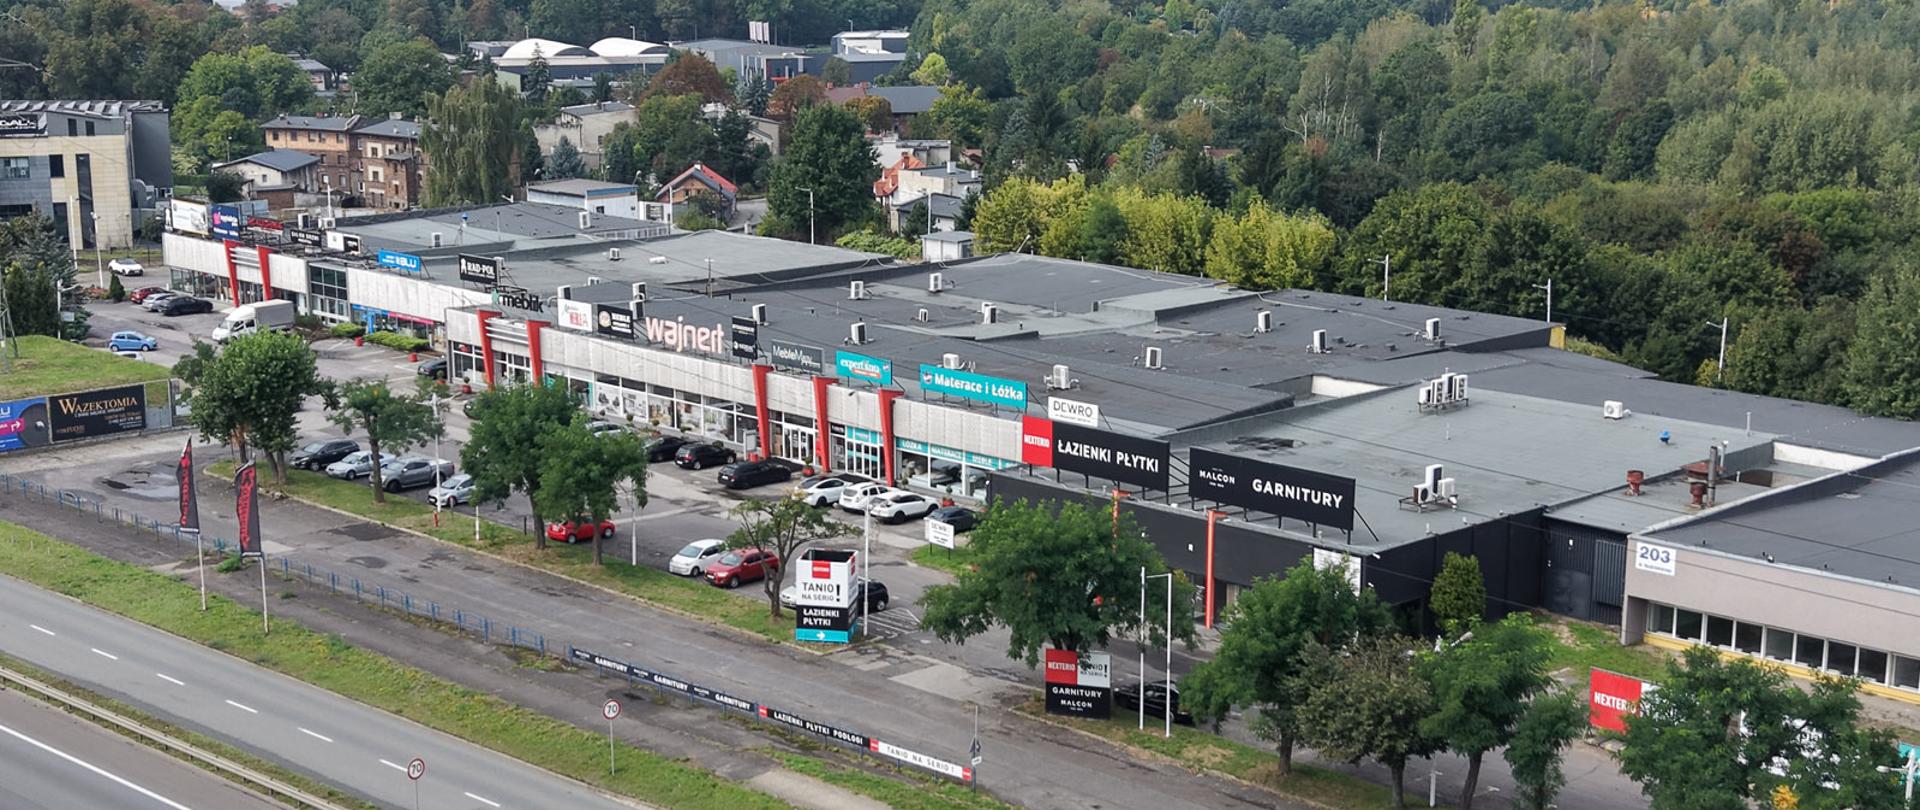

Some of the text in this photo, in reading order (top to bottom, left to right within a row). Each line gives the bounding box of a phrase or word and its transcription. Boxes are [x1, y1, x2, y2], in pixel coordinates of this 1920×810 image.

[503, 293, 543, 313] meblik
[646, 316, 725, 354] wajnert
[934, 373, 1023, 400] Materace i Łóżka
[1053, 400, 1093, 417] DEWRO
[1058, 439, 1159, 473] ŁAZIENKI PŁYTKI
[1199, 470, 1236, 485] MALCON
[1252, 479, 1343, 509] GARNITURY
[1640, 546, 1671, 563] 203
[802, 582, 834, 593] TANIO
[803, 608, 839, 618] ŁAZIENKI
[803, 618, 831, 627] PŁYTKI
[1052, 686, 1102, 698] GARNITURY
[607, 703, 617, 714] 70
[1060, 699, 1092, 708] MALCON
[411, 762, 421, 774] 70
